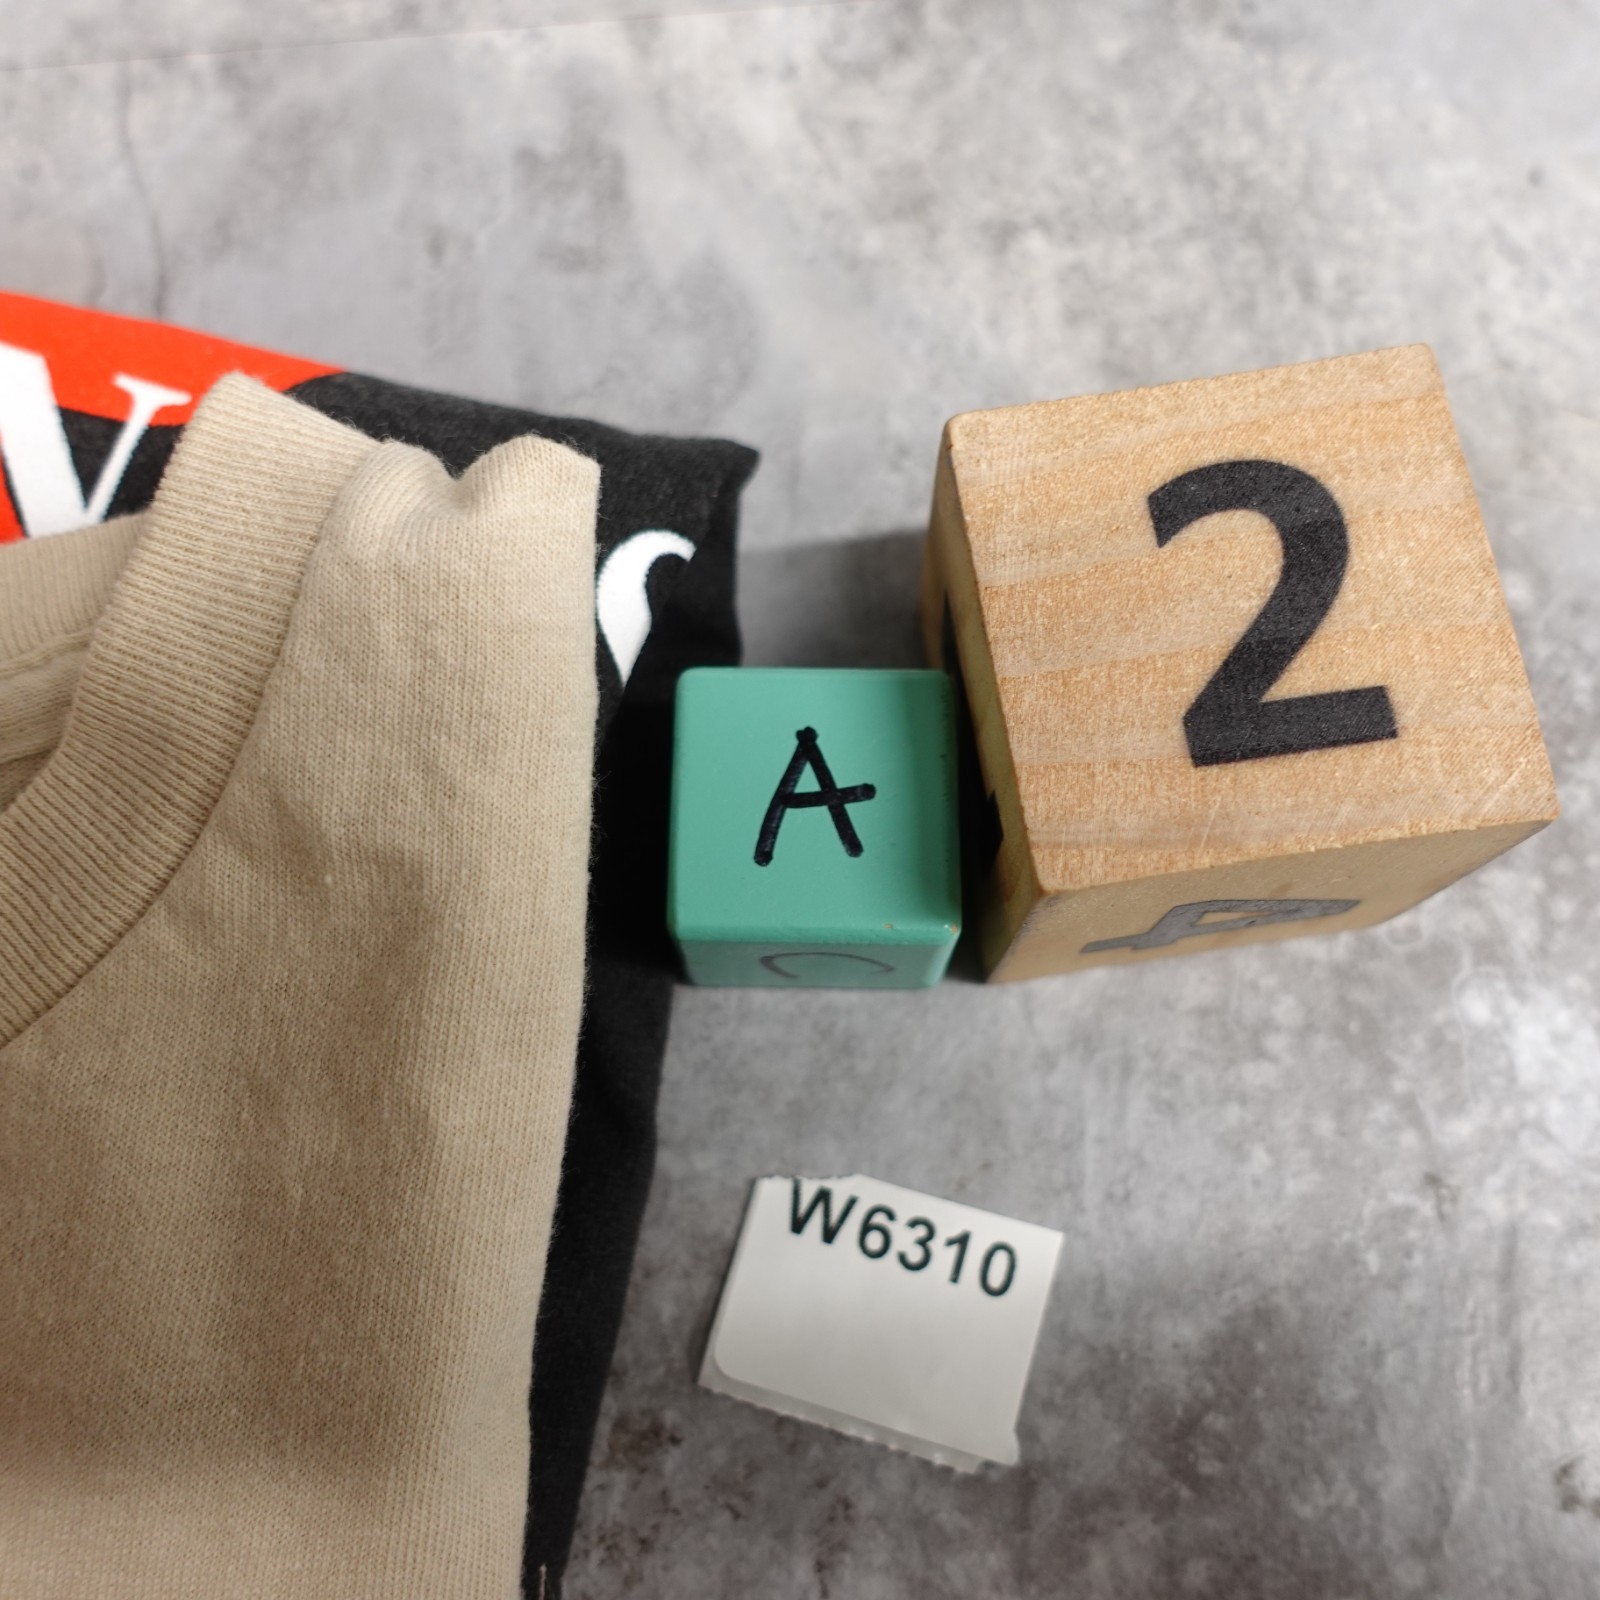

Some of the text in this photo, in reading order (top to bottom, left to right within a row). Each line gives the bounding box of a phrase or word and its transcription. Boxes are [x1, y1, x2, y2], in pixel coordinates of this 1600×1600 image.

[1147, 459, 1398, 768] 2
[753, 727, 877, 867] A
[1078, 899, 1362, 955] 4
[788, 1178, 1017, 1297] W6310
